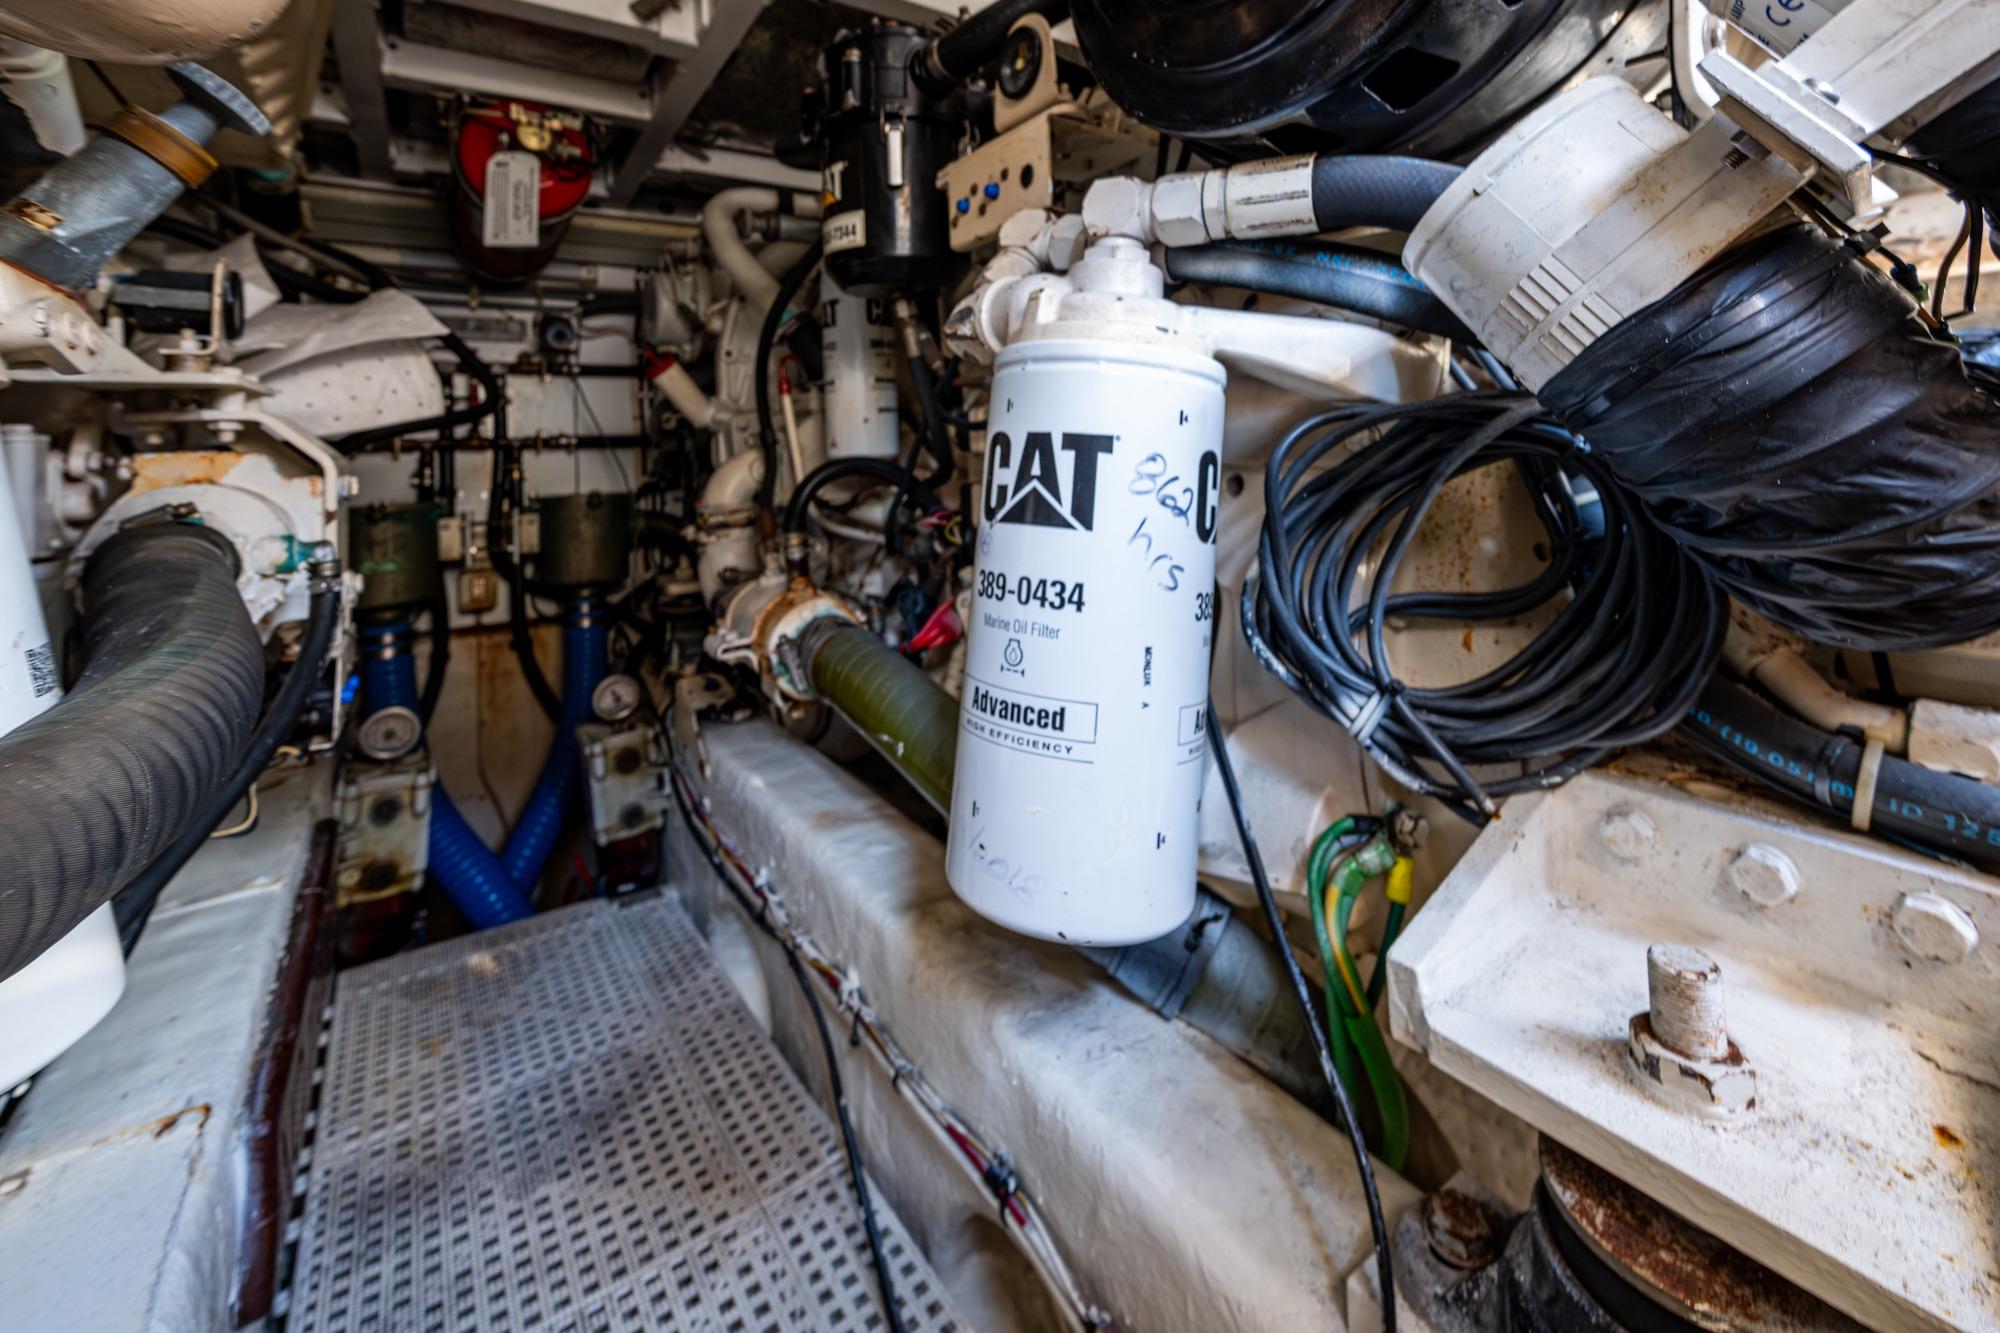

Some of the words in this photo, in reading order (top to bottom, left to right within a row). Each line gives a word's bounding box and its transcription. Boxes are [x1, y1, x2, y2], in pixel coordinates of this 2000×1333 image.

[984, 431, 1114, 532] CAT
[1128, 452, 1194, 527] 862
[977, 569, 1086, 613] 389-0434
[983, 612, 1011, 632] Marine
[1013, 618, 1028, 635] Oil
[1031, 621, 1061, 640] Filter
[971, 685, 1066, 733] Advanced
[966, 717, 986, 733] HIGH
[989, 728, 1074, 755] EFFICIENCY
